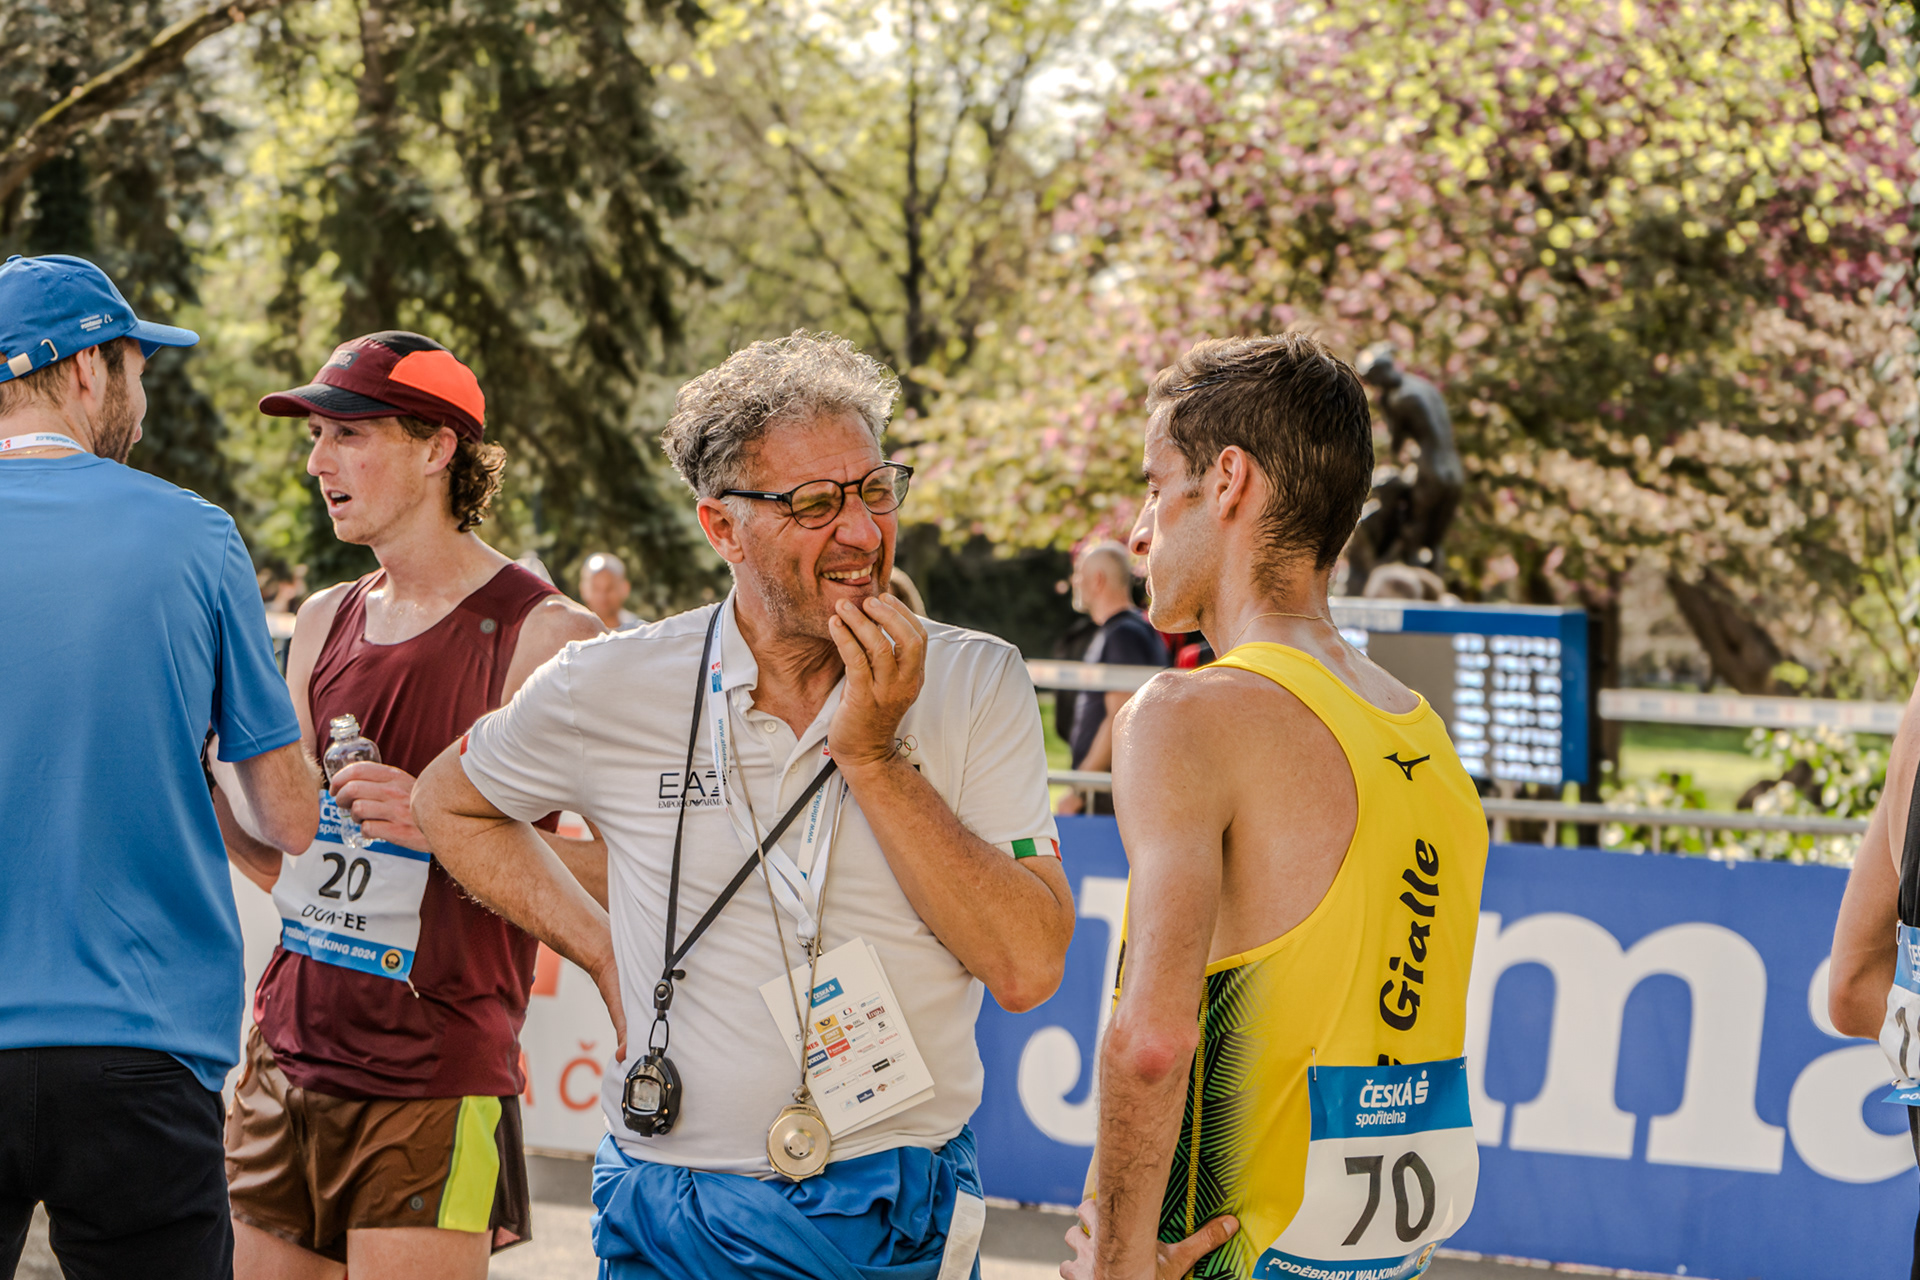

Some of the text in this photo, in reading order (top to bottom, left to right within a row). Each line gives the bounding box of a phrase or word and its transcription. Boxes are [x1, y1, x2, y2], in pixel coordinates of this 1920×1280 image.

[318, 852, 371, 902] 20
[308, 934, 349, 955] WALKING
[350, 946, 377, 961] 2024
[1379, 838, 1440, 1031] Gialle
[1359, 1077, 1413, 1109] ČESKÁ
[1355, 1109, 1407, 1128] spořitelna
[1340, 1150, 1436, 1247] 70
[1268, 1256, 1354, 1280] PODĚBRADY
[1354, 1264, 1401, 1280] WALKING
